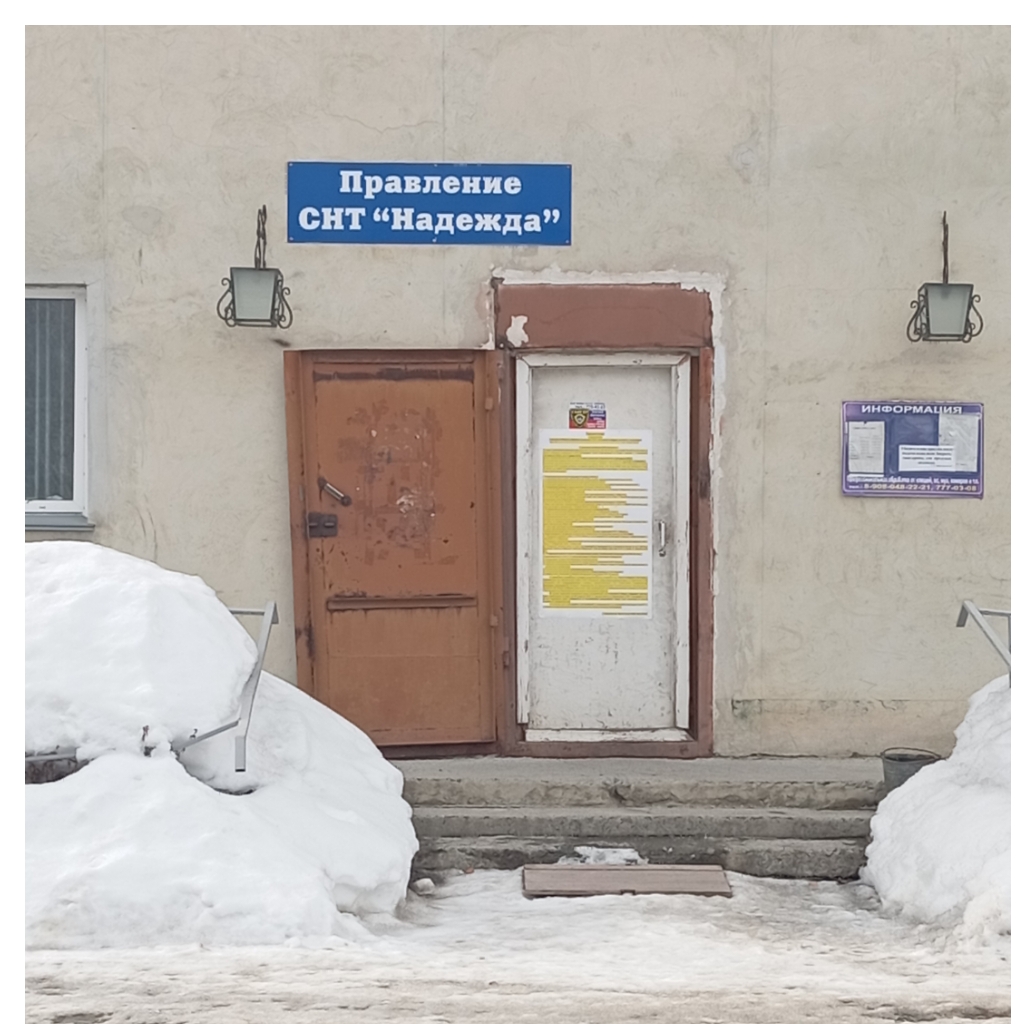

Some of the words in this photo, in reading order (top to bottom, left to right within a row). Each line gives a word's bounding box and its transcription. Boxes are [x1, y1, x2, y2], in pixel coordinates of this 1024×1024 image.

[339, 170, 522, 199] Правление
[298, 206, 366, 231] СНТ
[861, 404, 962, 415] ИНФОРМАЦИЯ
